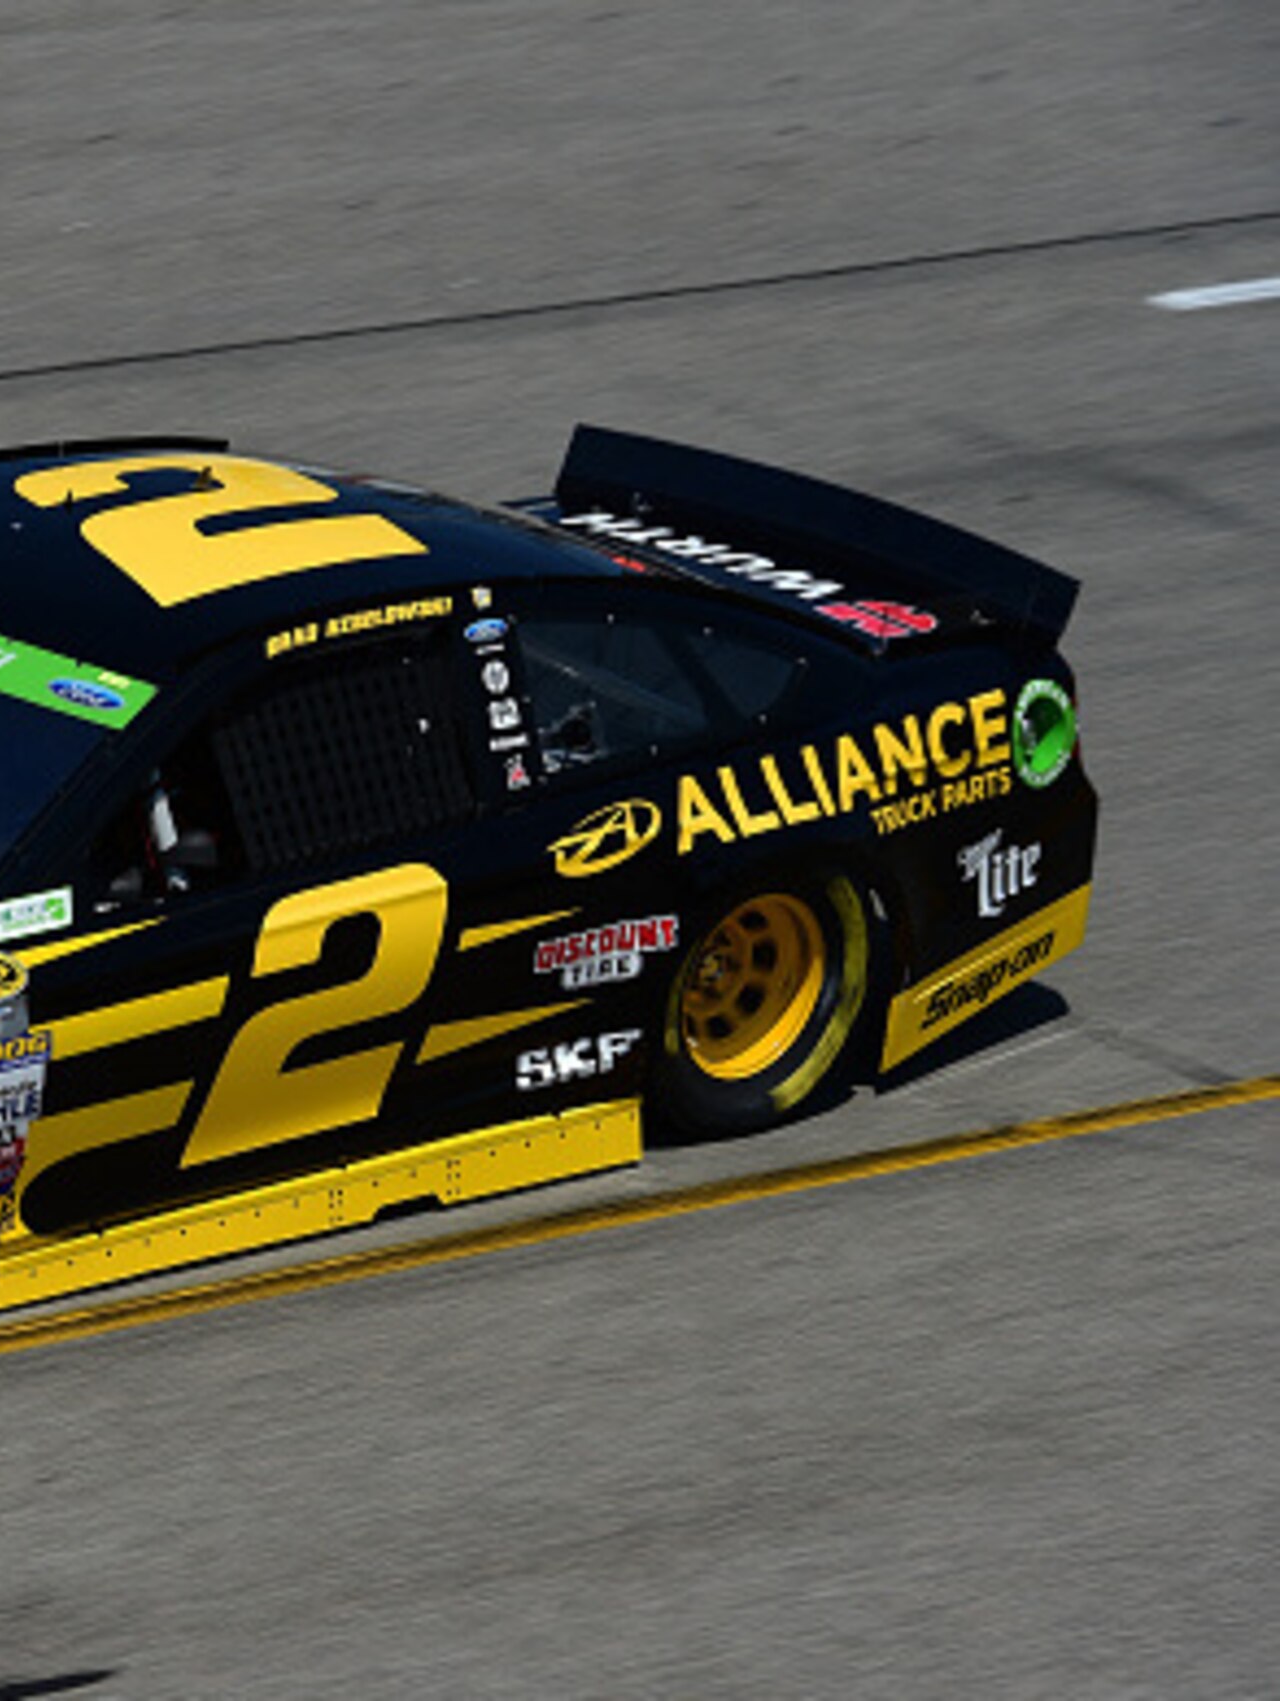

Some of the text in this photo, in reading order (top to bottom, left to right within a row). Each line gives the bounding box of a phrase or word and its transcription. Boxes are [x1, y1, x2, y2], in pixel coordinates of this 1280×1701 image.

[14, 454, 428, 607] 2
[677, 688, 1012, 856] ALLIANCE
[870, 791, 938, 836] TRUCK
[942, 767, 1013, 812] PARTS
[956, 828, 1042, 918] Lite
[534, 915, 678, 973] DISCOUNT
[566, 953, 637, 987] TIRE
[179, 862, 448, 1169] 2
[516, 1028, 642, 1090] SKF
